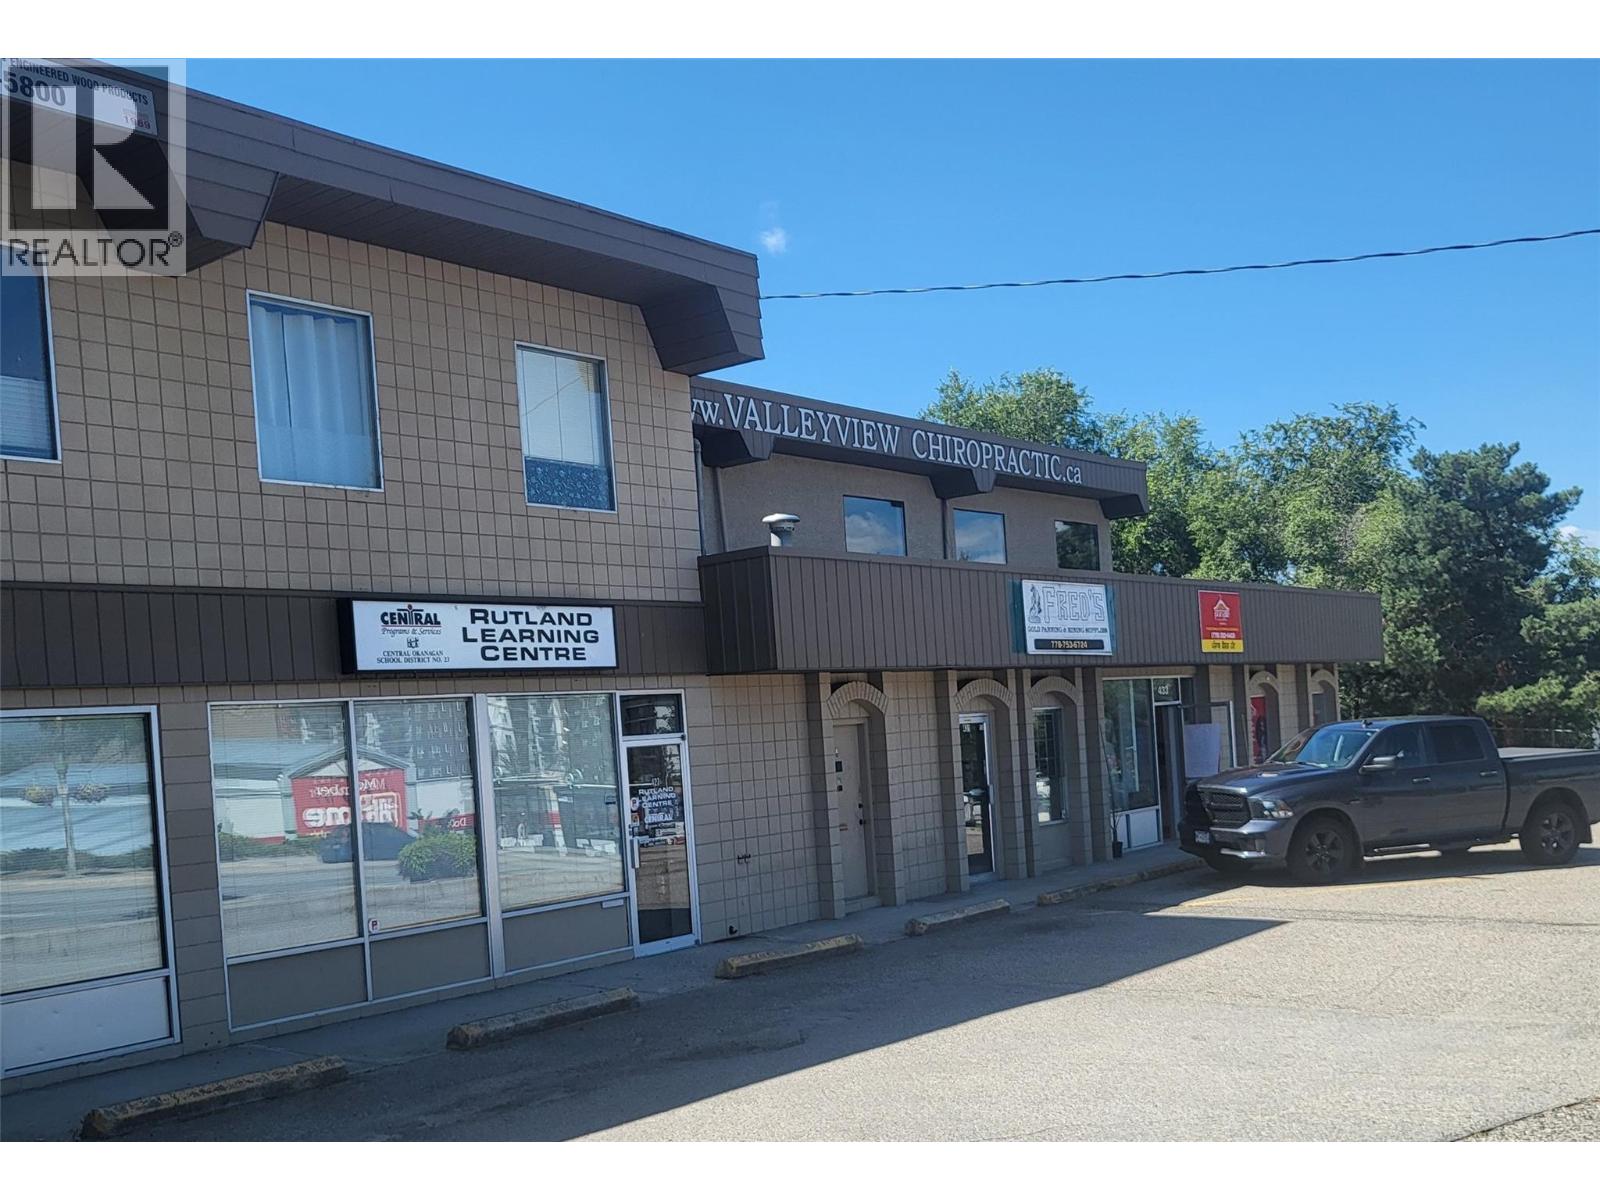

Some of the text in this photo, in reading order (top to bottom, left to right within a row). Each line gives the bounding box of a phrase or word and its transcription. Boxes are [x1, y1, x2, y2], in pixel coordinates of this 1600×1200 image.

[10, 58, 149, 105] ENGINEERED WOOD PRODUCTS
[912, 430, 1082, 484] CHIROPRACTIC.ca
[380, 606, 442, 626] CENTRAL
[469, 608, 593, 626] RUTLAND
[381, 628, 410, 638] Programs
[418, 628, 442, 636] Services
[462, 627, 600, 643] LEARNING
[480, 645, 587, 661] CENTRE
